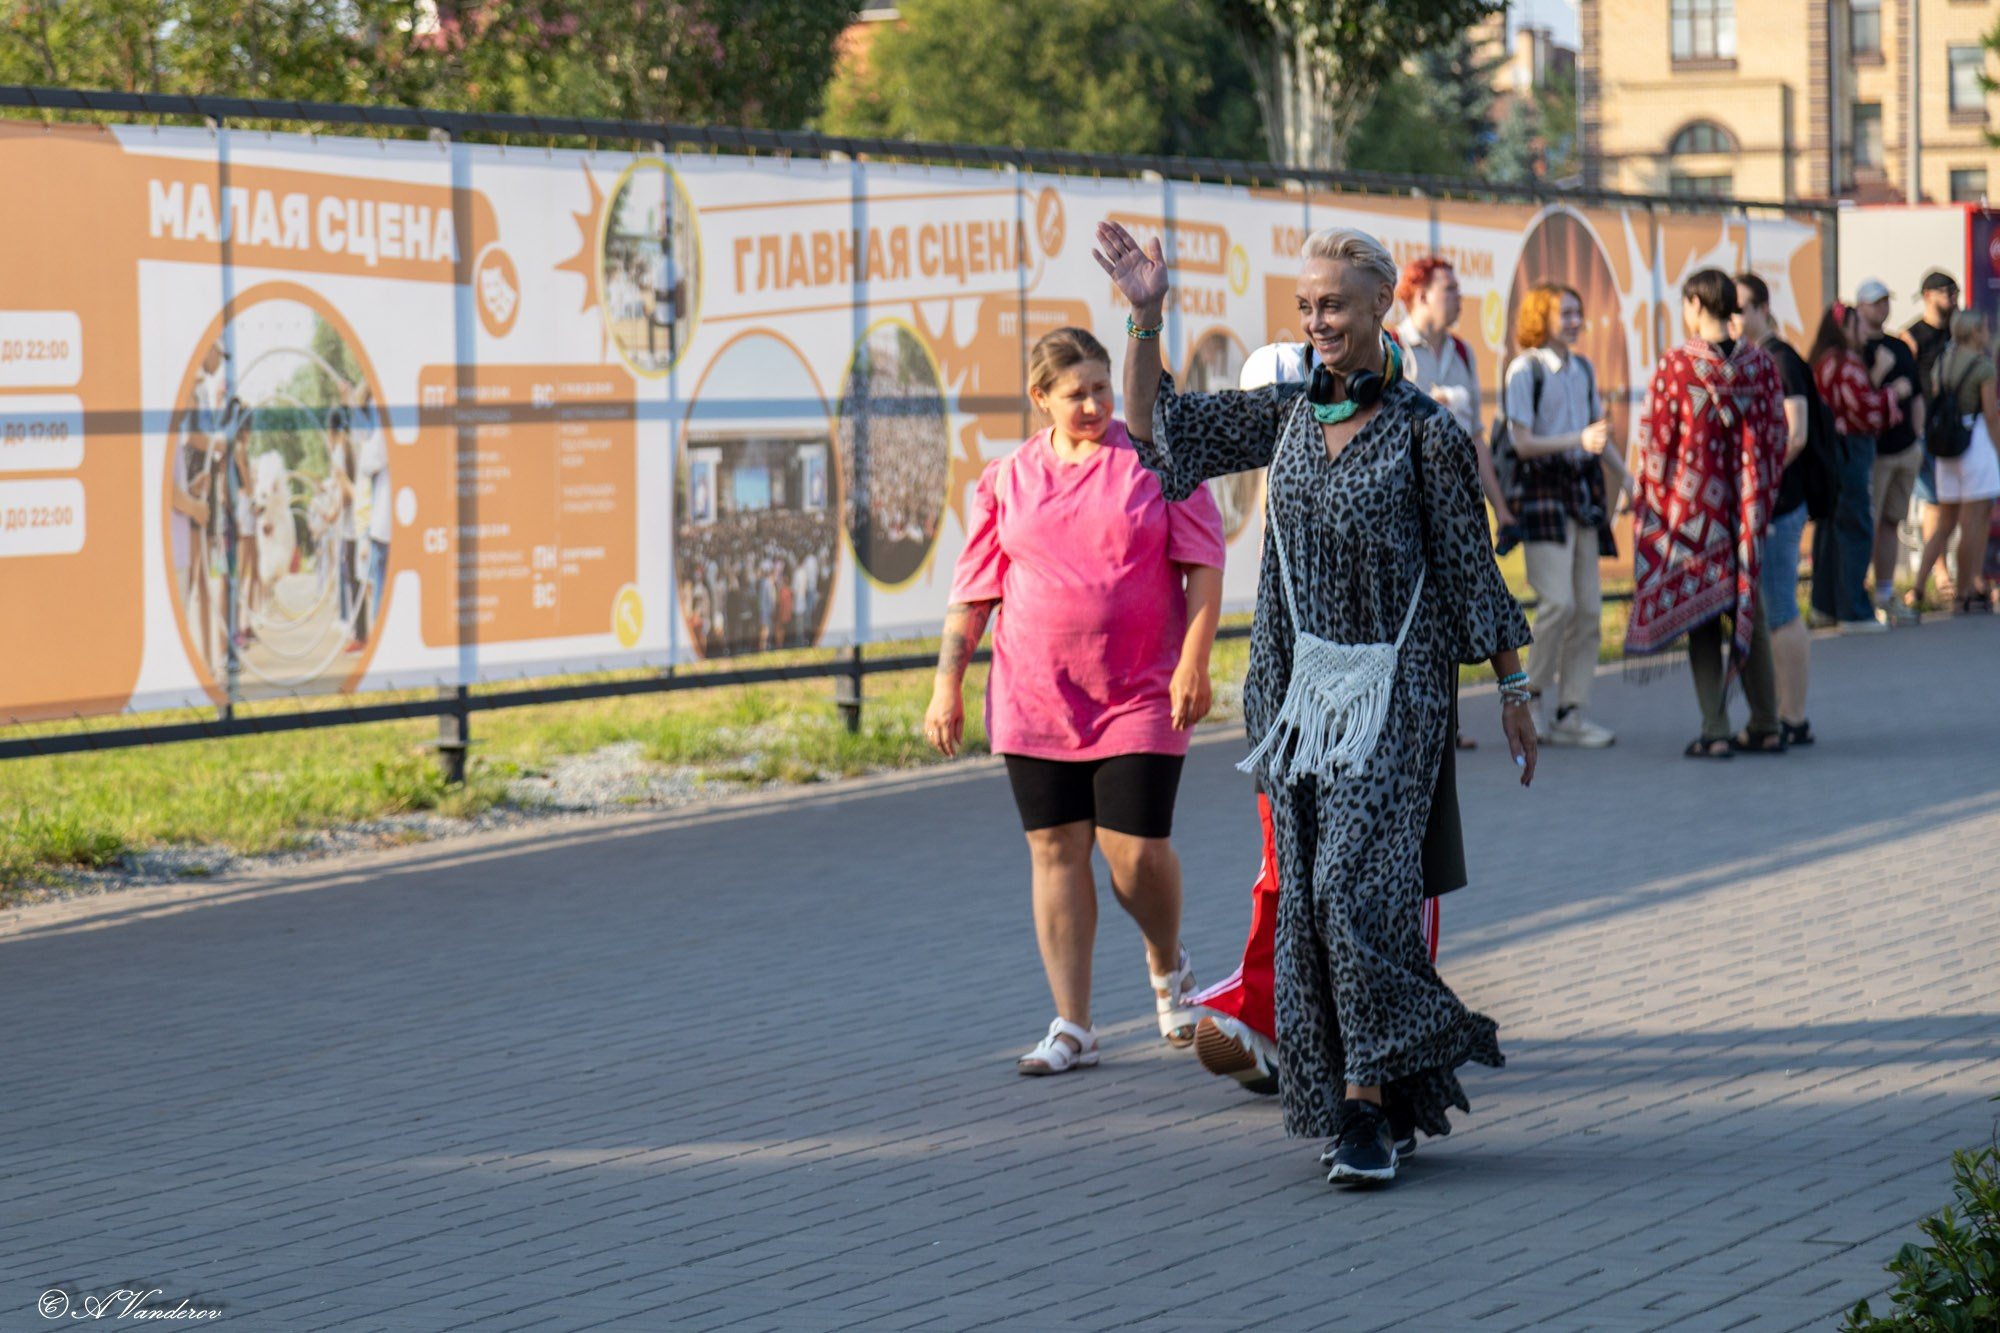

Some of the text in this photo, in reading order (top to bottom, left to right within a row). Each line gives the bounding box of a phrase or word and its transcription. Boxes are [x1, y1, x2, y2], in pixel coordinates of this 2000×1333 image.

[149, 179, 461, 266] МАЛАЯ СЦЕНА
[733, 219, 1034, 294] ГЛАВНАЯ СЦЕНА
[2, 339, 69, 362] ДО 22:00
[5, 422, 25, 446] ДО
[6, 505, 73, 531] ДО 22:00
